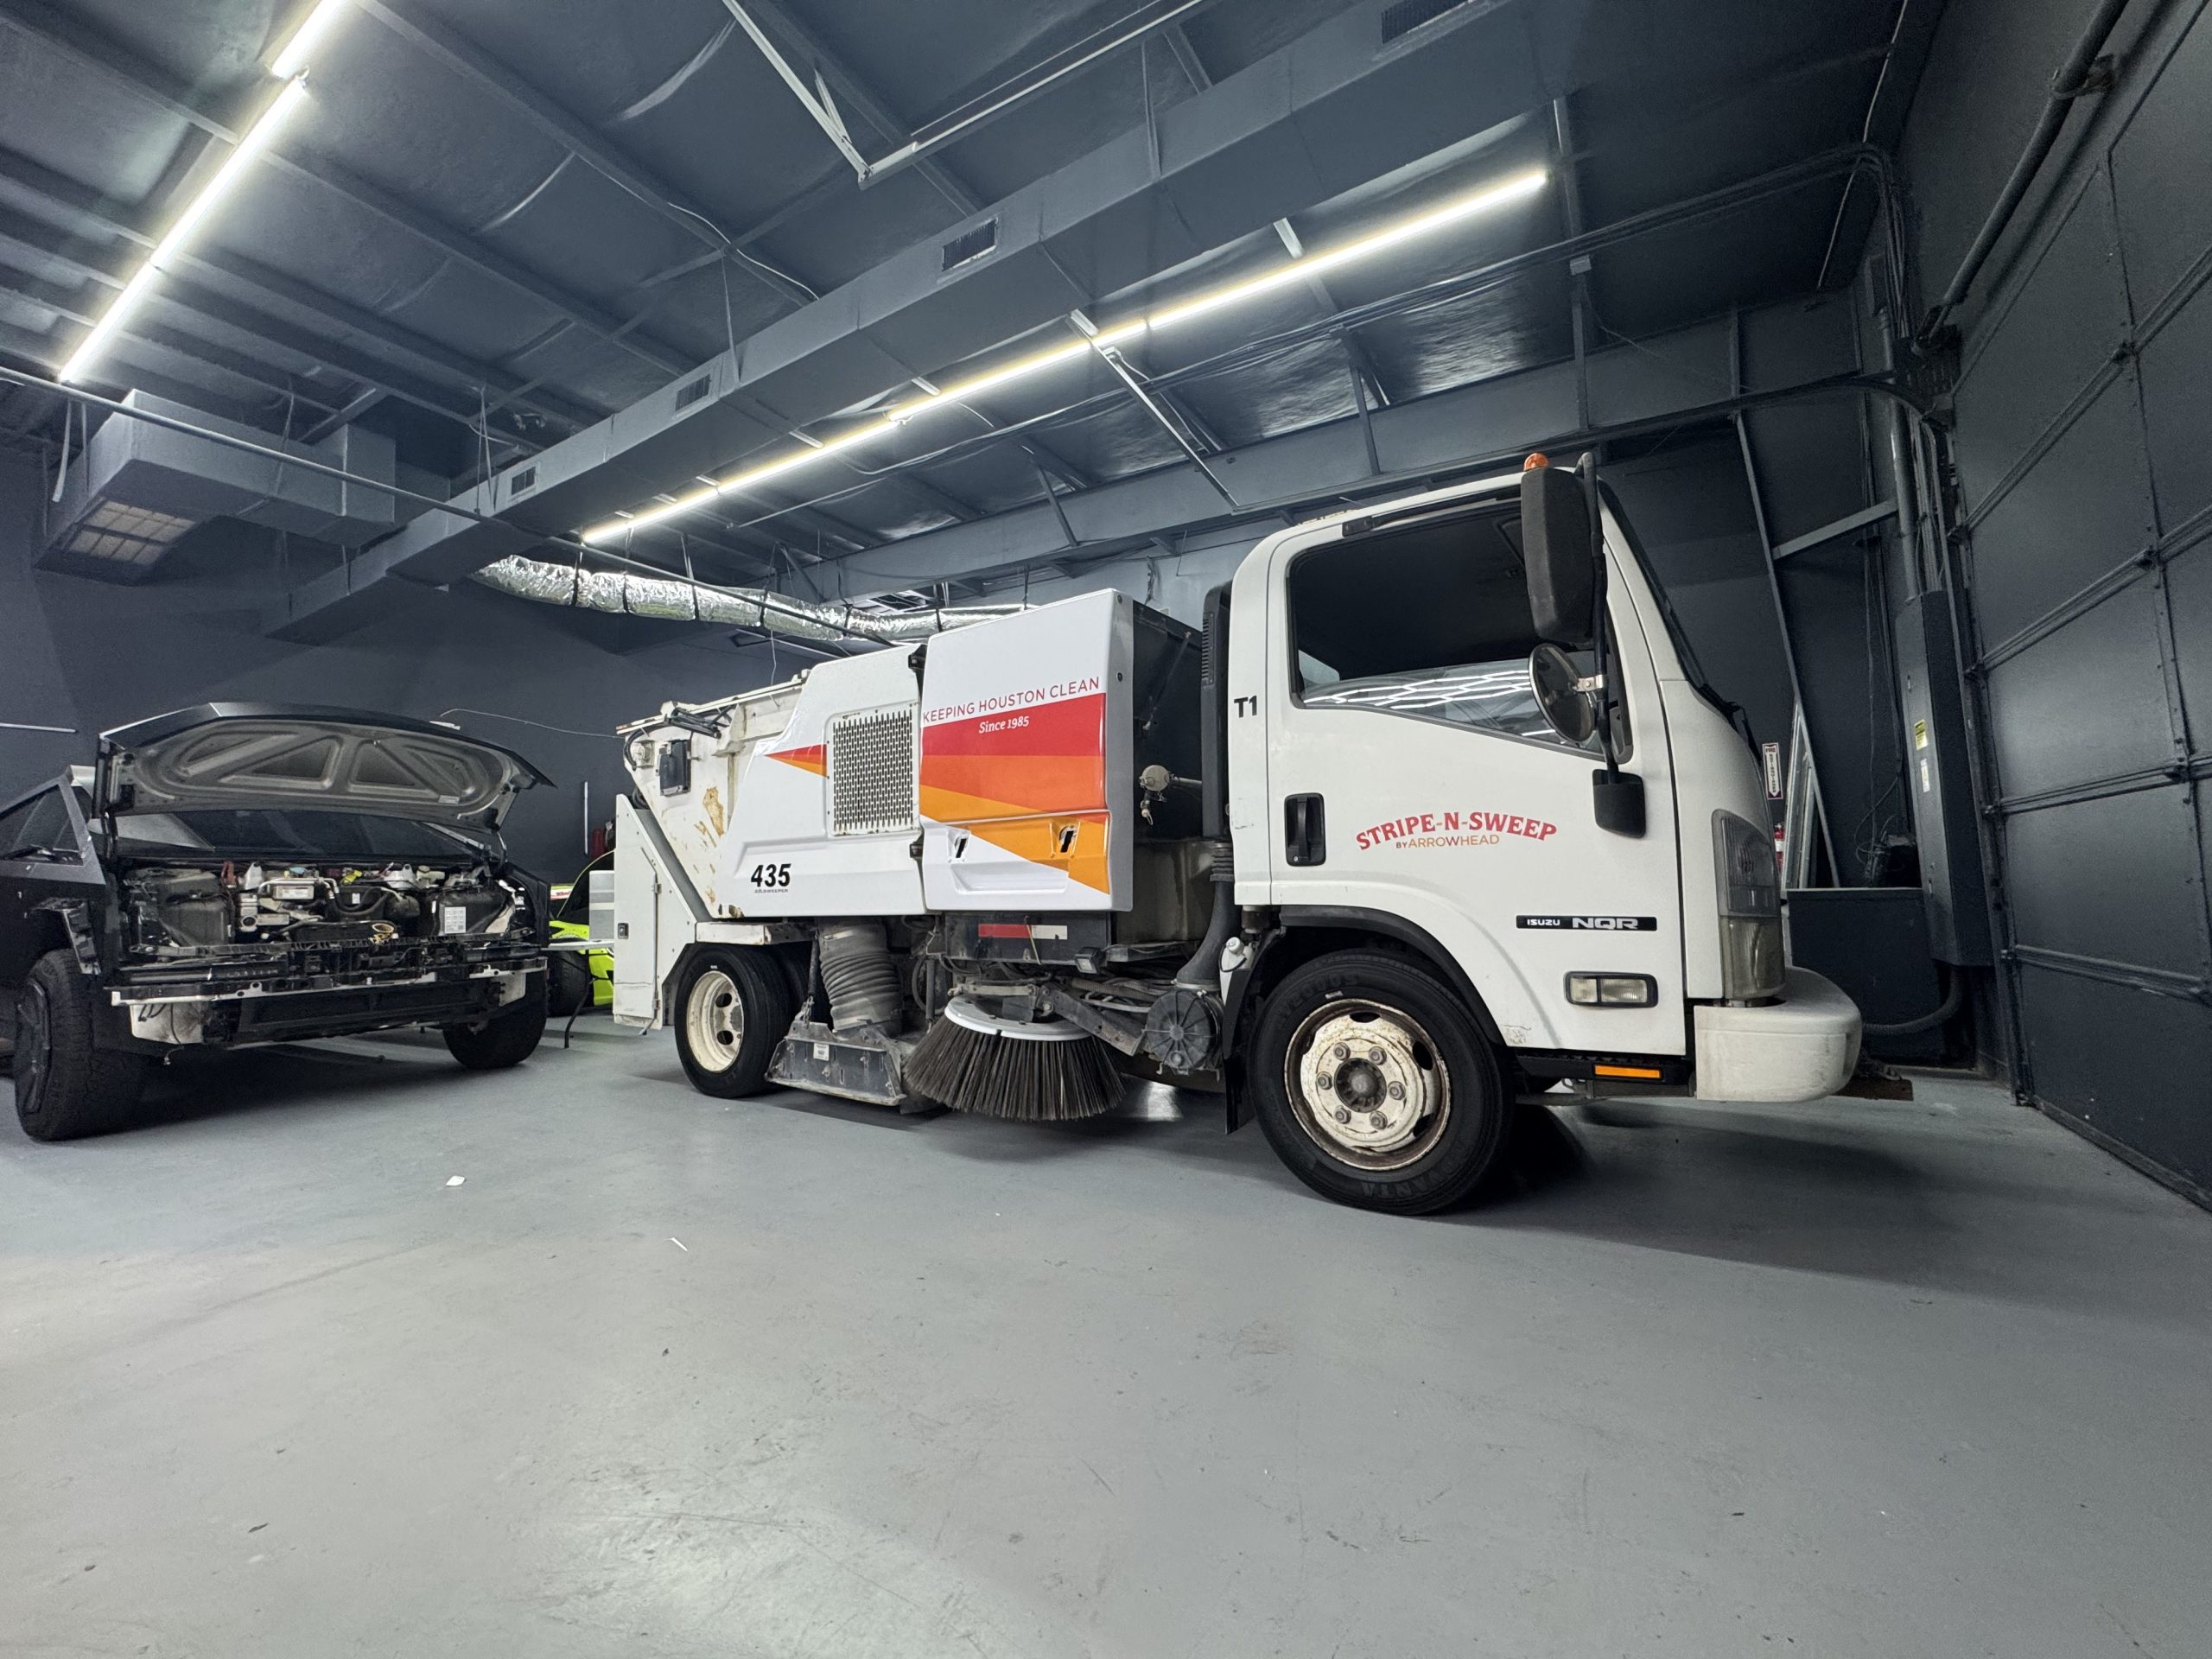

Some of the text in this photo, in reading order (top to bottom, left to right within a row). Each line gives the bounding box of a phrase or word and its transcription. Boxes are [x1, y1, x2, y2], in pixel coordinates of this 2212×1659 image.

[923, 677, 1099, 723] KEEPING HOUSTON CLEAN
[1234, 695, 1257, 718] T1
[978, 715, 1029, 734] Since 1985
[1408, 835, 1500, 849] ARROWHEAD
[751, 863, 791, 887] 435
[1572, 918, 1638, 930] NQR
